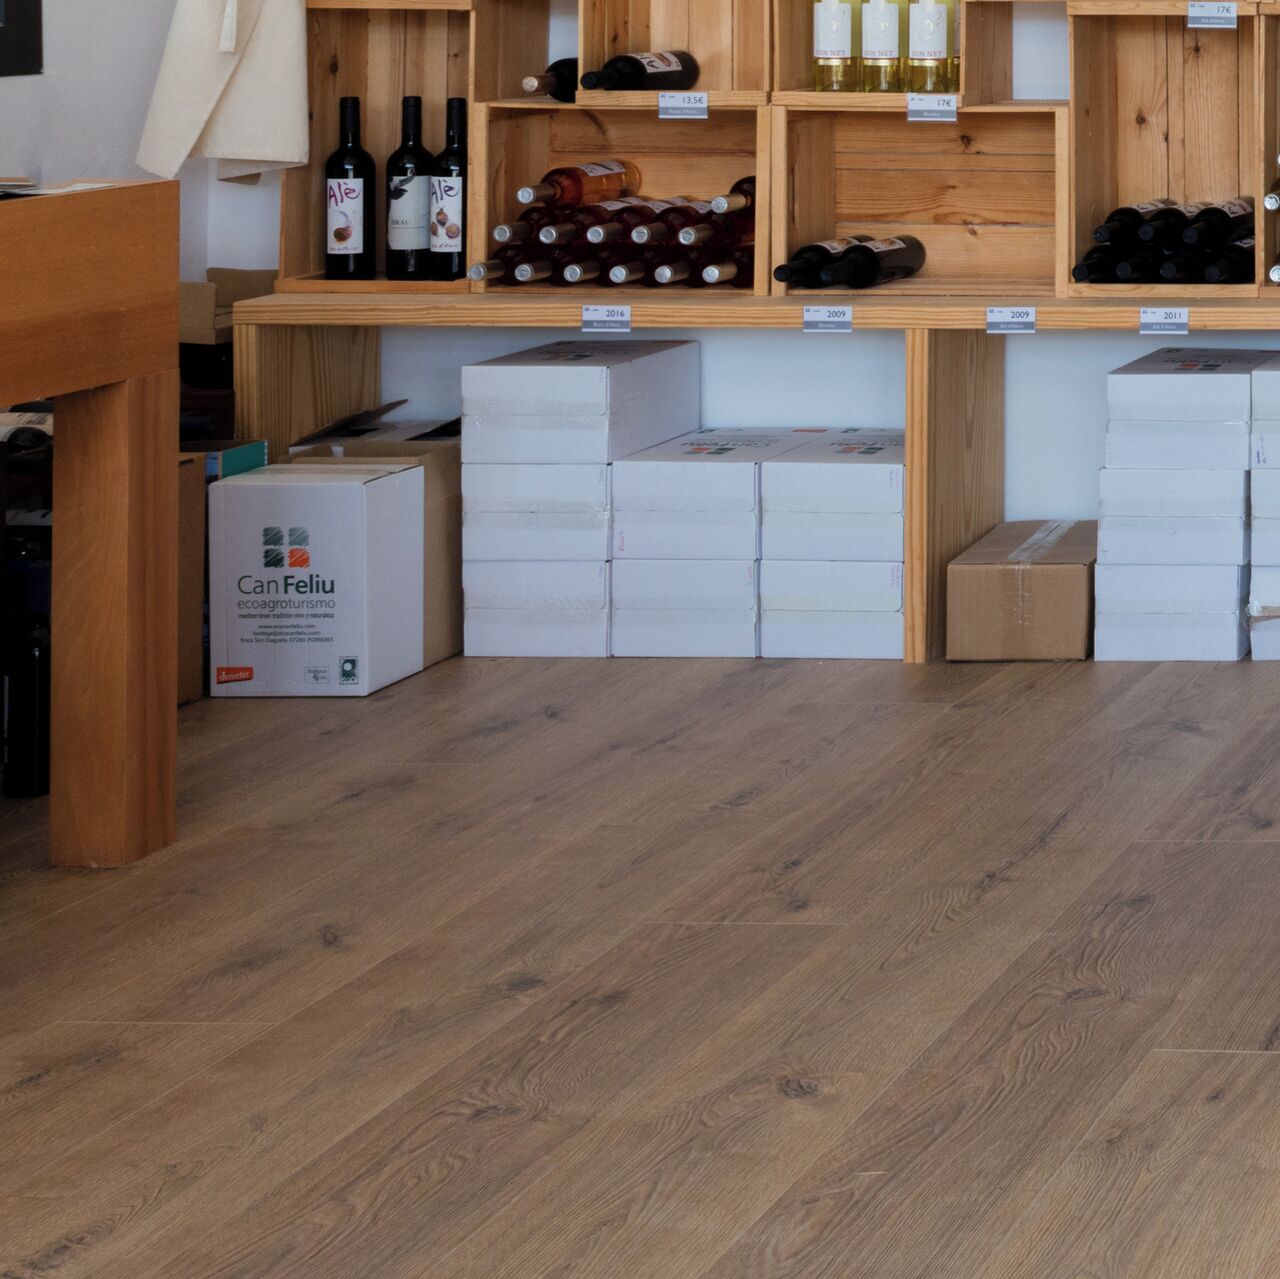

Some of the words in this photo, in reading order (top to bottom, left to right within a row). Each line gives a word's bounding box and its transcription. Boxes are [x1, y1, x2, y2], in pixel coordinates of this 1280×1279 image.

[1217, 5, 1232, 15] 17€
[937, 99, 952, 108] 17€
[606, 309, 625, 319] 2016
[827, 310, 846, 319] 2009
[1010, 310, 1030, 320] 2009
[1163, 311, 1182, 320] 2011
[238, 575, 279, 595] Can
[284, 574, 336, 594] Feliu
[237, 599, 336, 613] ecoagroturismo
[218, 671, 250, 682] demeter
